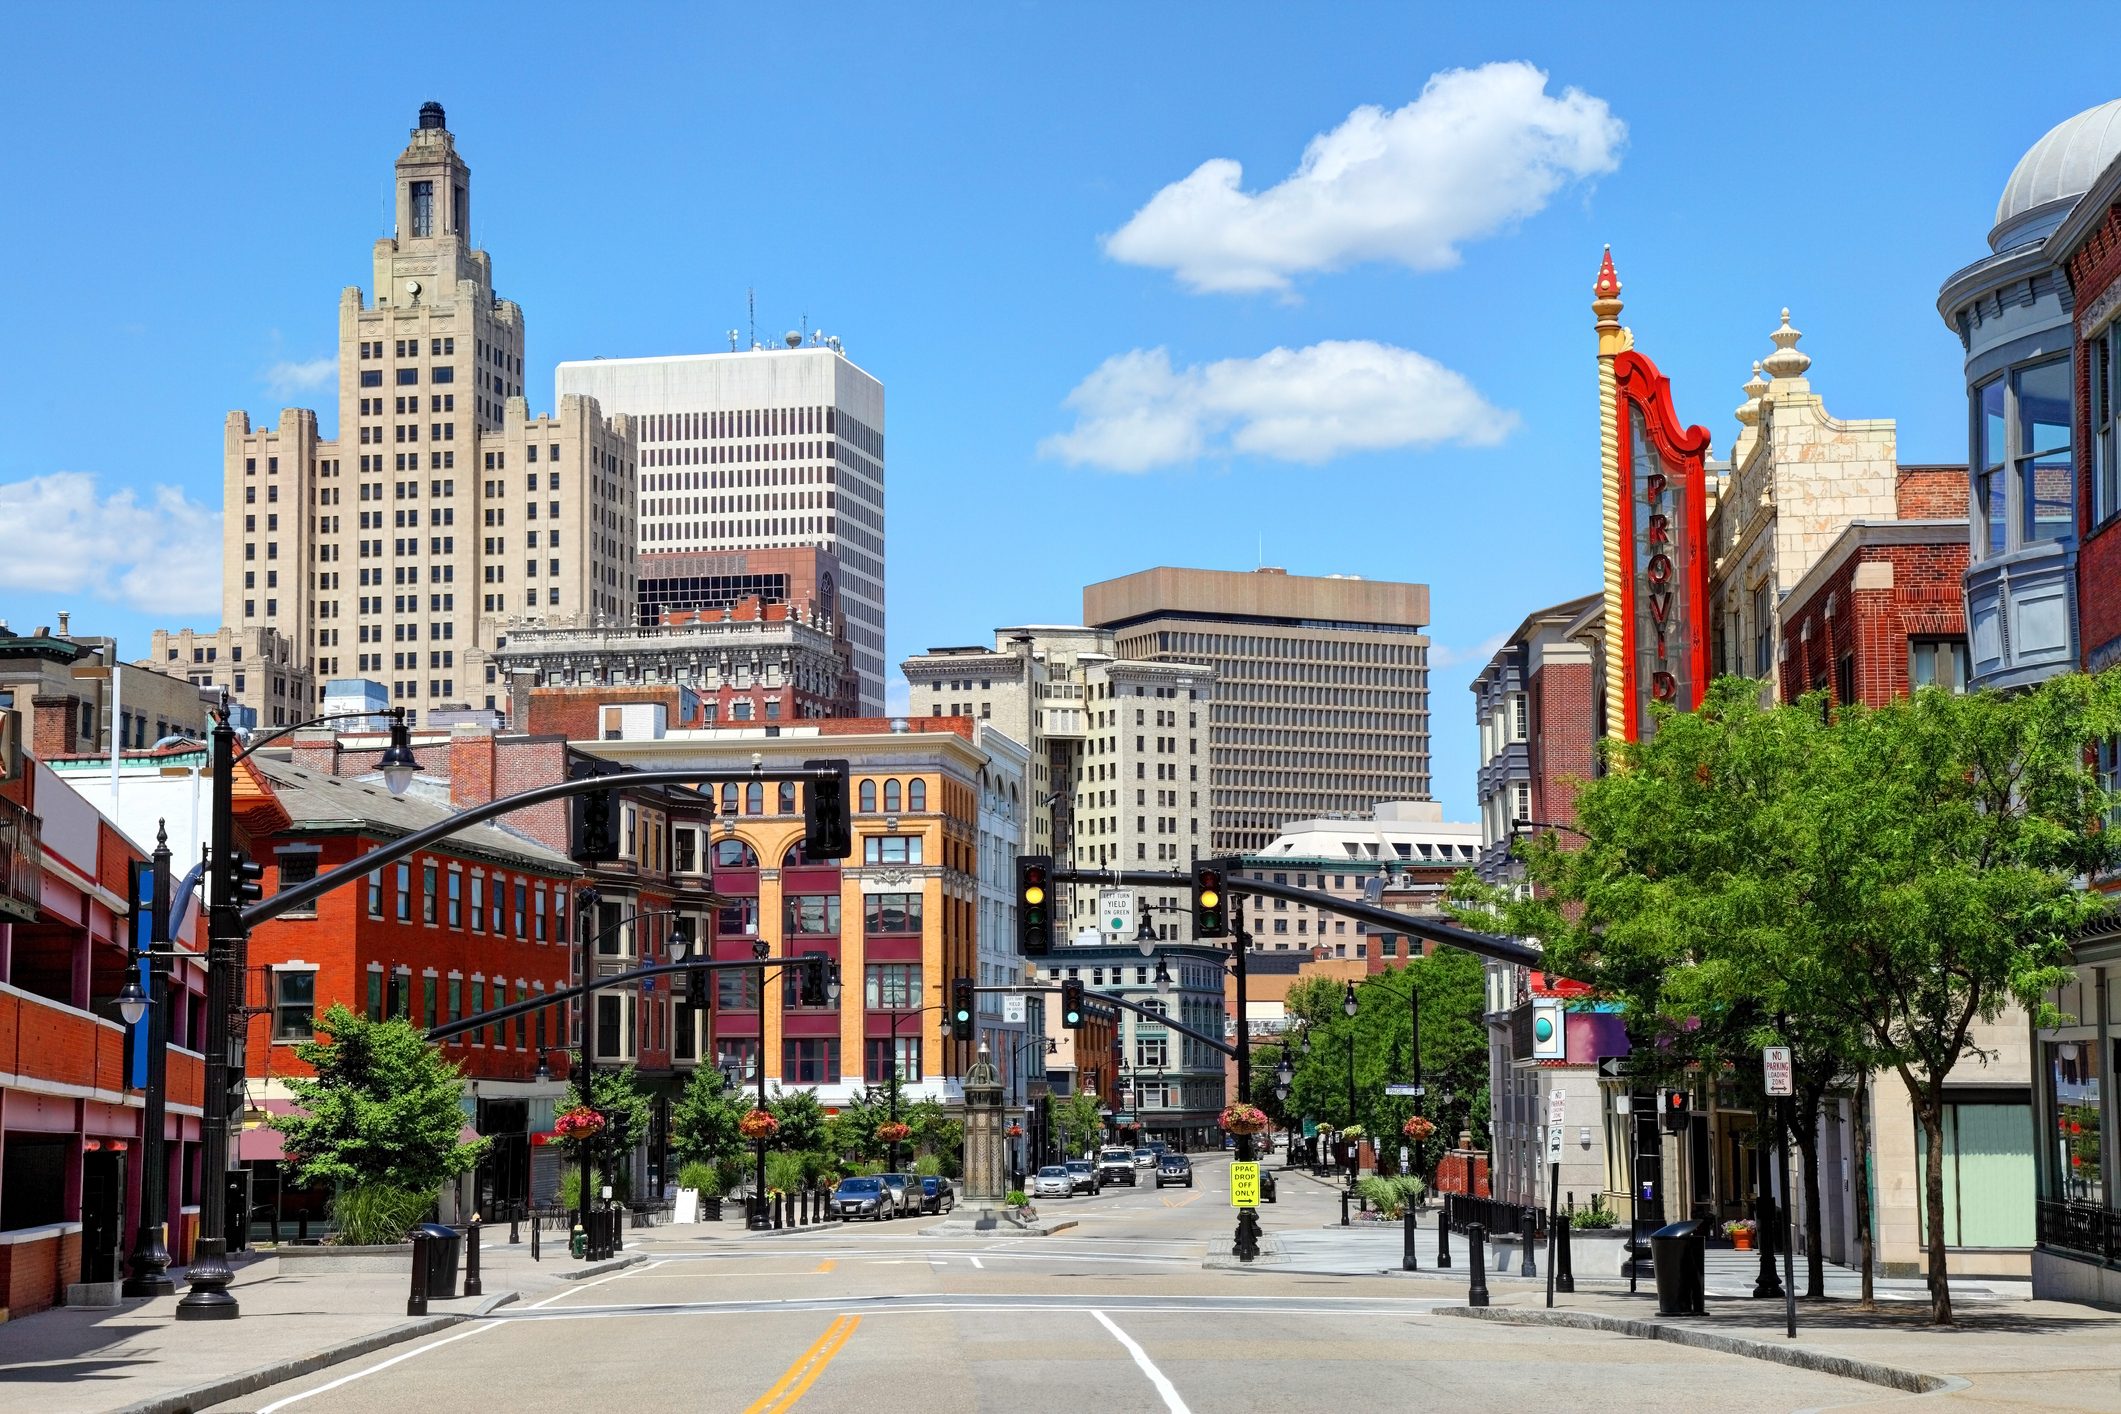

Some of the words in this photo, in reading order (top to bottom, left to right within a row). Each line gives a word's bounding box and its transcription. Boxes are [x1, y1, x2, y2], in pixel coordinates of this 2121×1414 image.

[1648, 473, 1676, 700] PROVID
[1771, 1051, 1783, 1060] NO
[1766, 1062, 1789, 1070] PARKING
